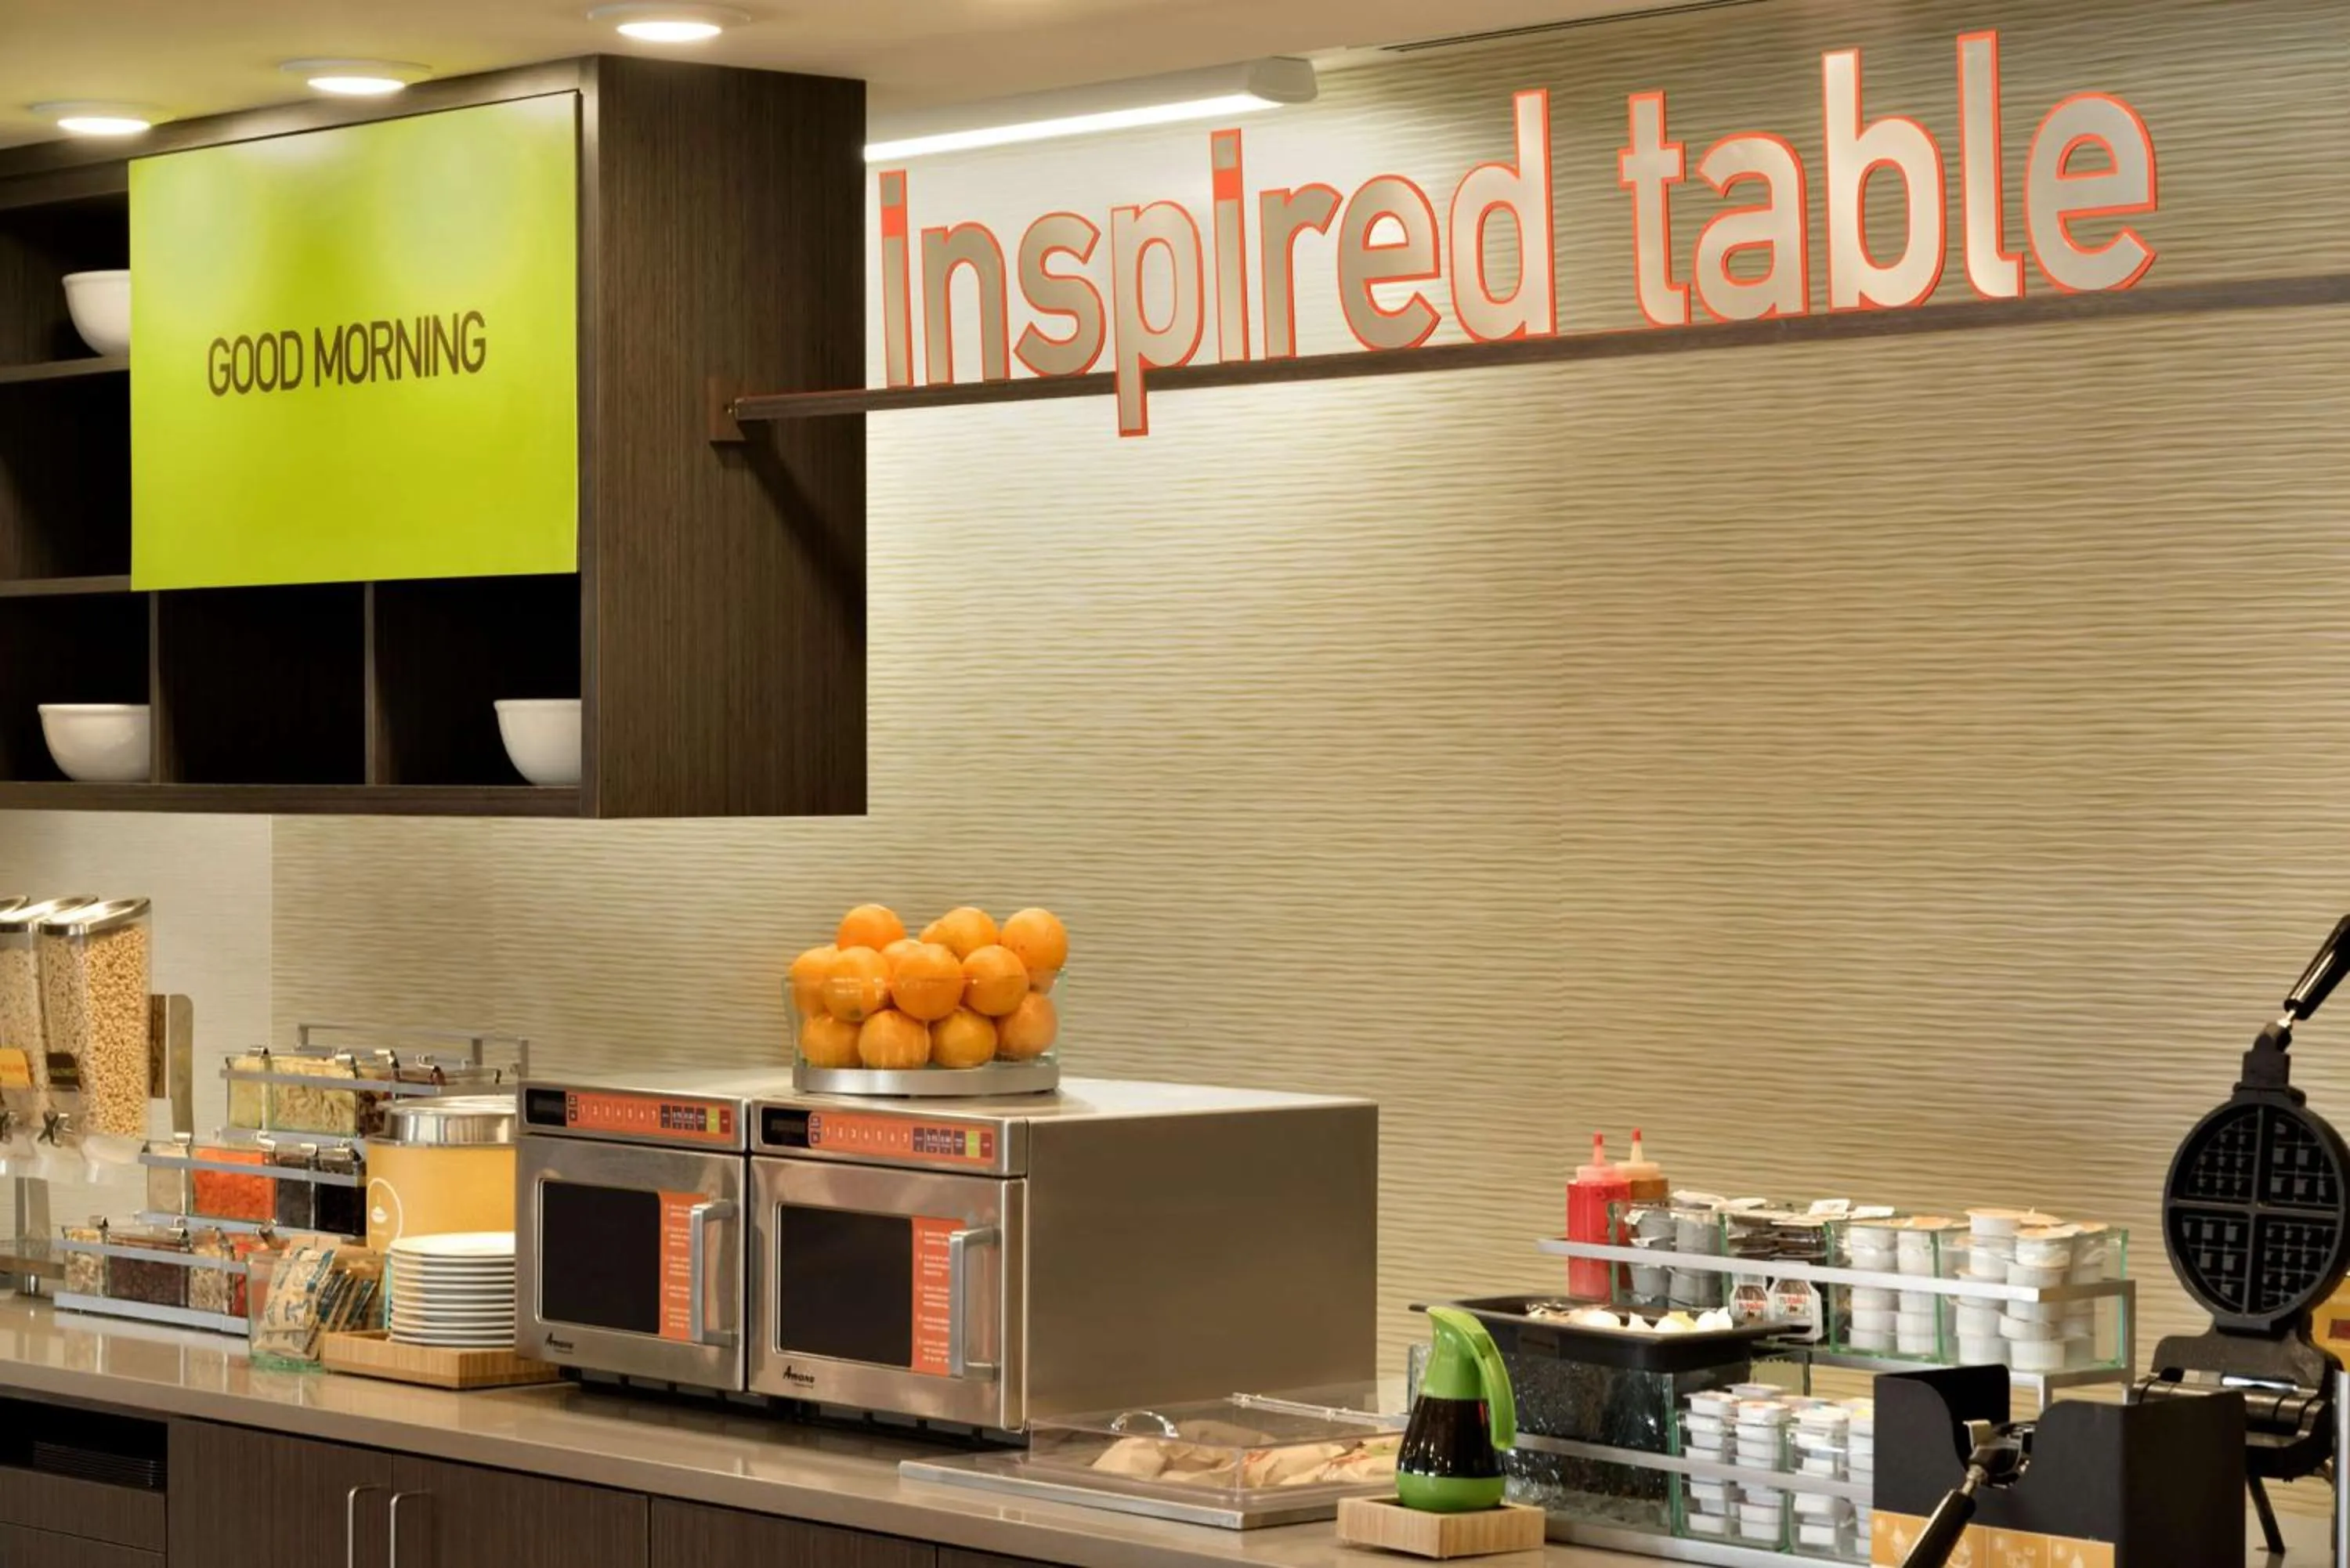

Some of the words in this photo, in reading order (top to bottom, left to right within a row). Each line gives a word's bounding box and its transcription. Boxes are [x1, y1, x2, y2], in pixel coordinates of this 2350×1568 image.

[208, 337, 303, 396] GOOD
[315, 310, 486, 388] MORNING
[879, 88, 1557, 436] inspired
[1618, 29, 2157, 328] table
